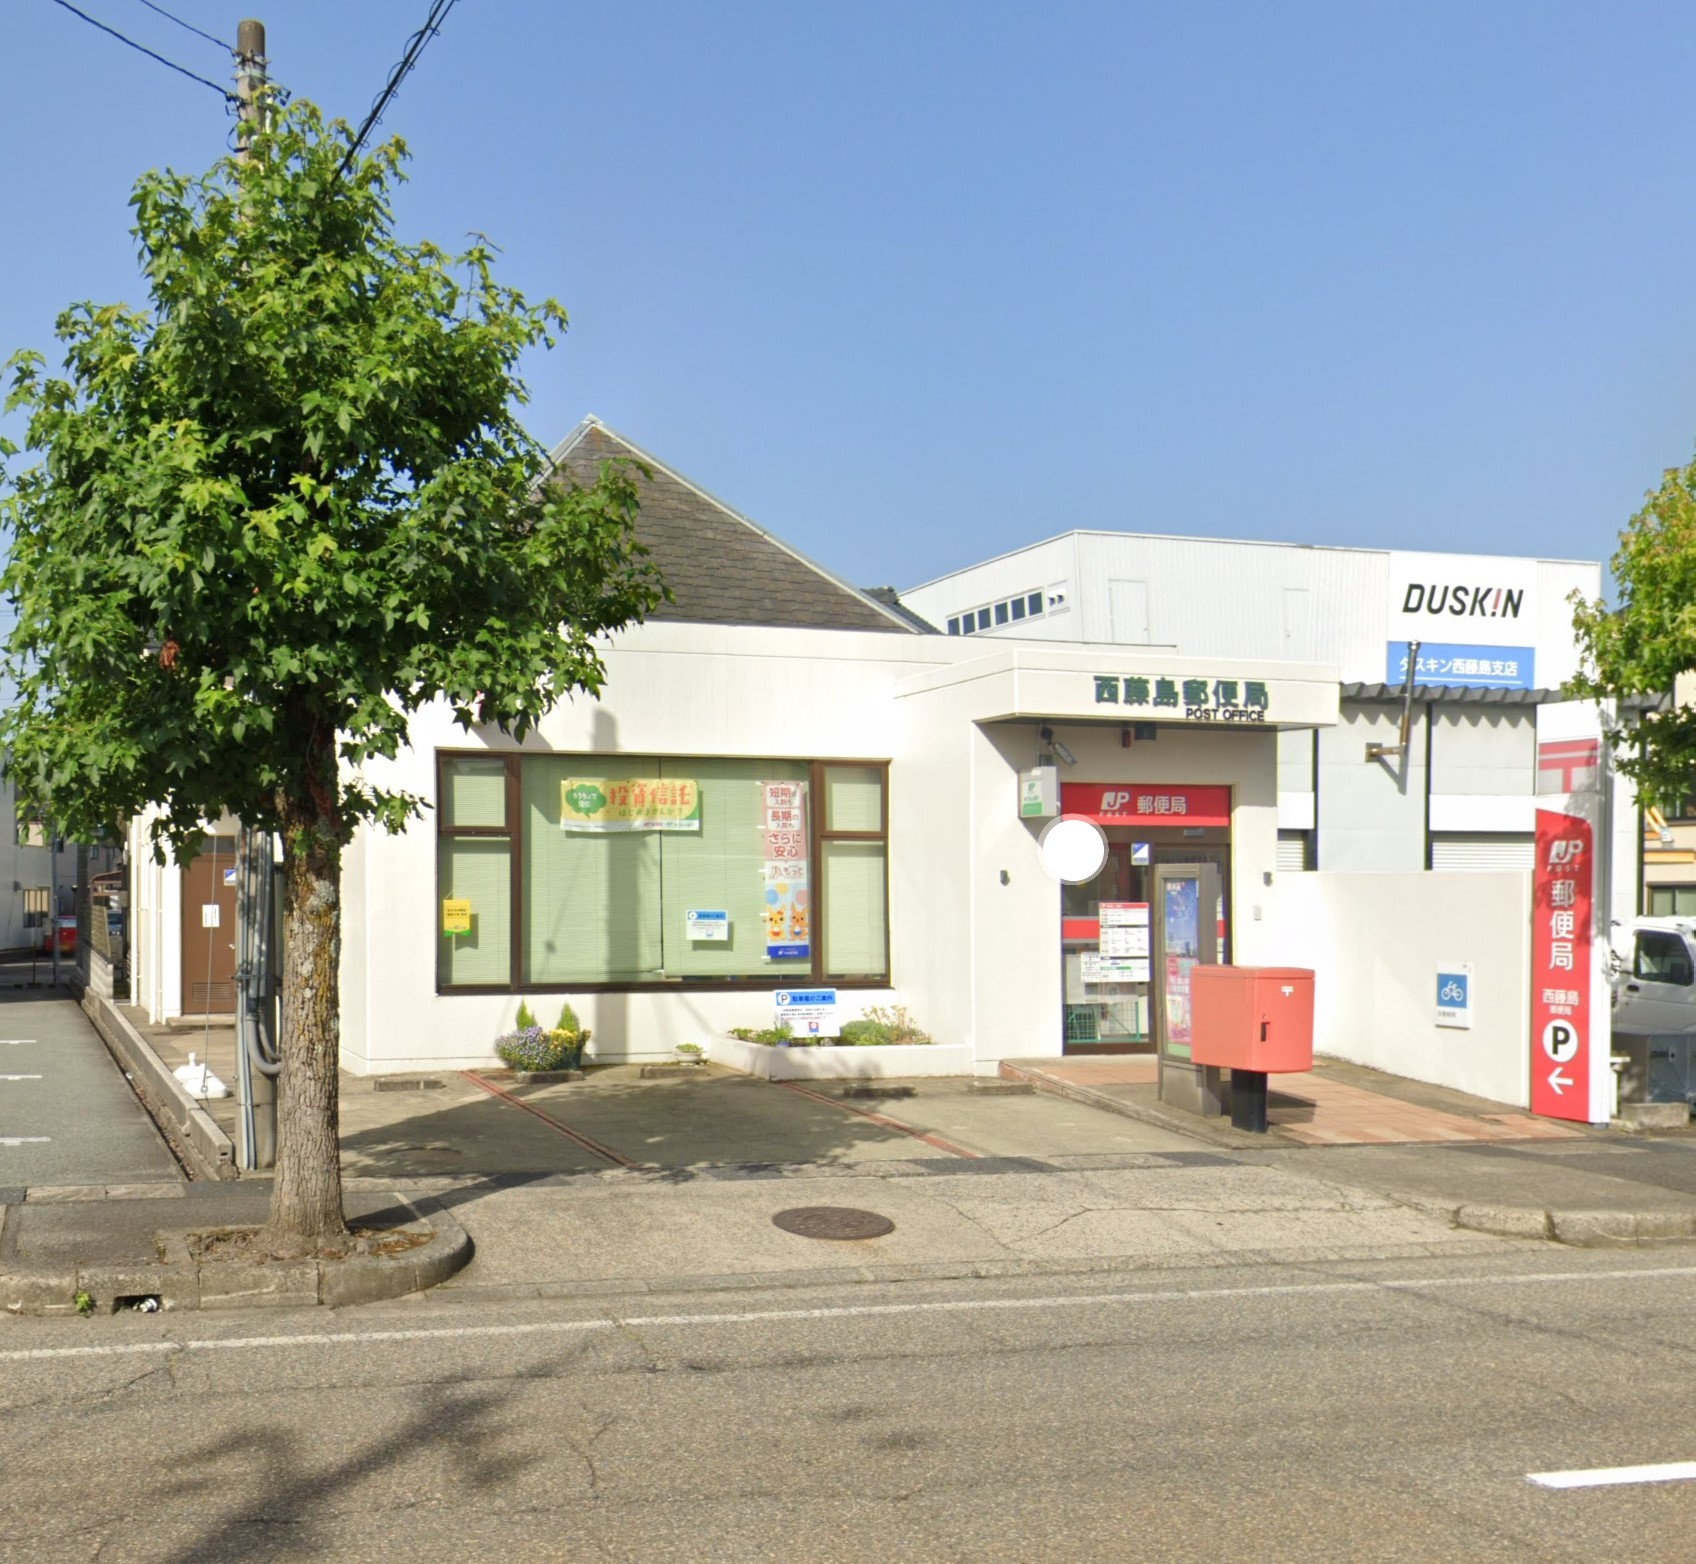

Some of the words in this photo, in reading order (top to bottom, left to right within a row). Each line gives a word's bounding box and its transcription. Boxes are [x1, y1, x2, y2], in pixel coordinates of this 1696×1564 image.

[1093, 675, 1269, 711] 西藤島郵便局
[1186, 707, 1219, 721] POST
[1222, 708, 1265, 722] OFFICE
[609, 783, 690, 807] 投資信託
[1136, 795, 1187, 815] 郵便局
[771, 811, 799, 822] 長期の
[769, 833, 802, 845] さらに
[773, 846, 799, 858] 安心
[1546, 864, 1580, 872] POST
[1549, 879, 1576, 972] 郵便局
[1542, 988, 1580, 1006] 西藤島
[1552, 1025, 1571, 1055] P
